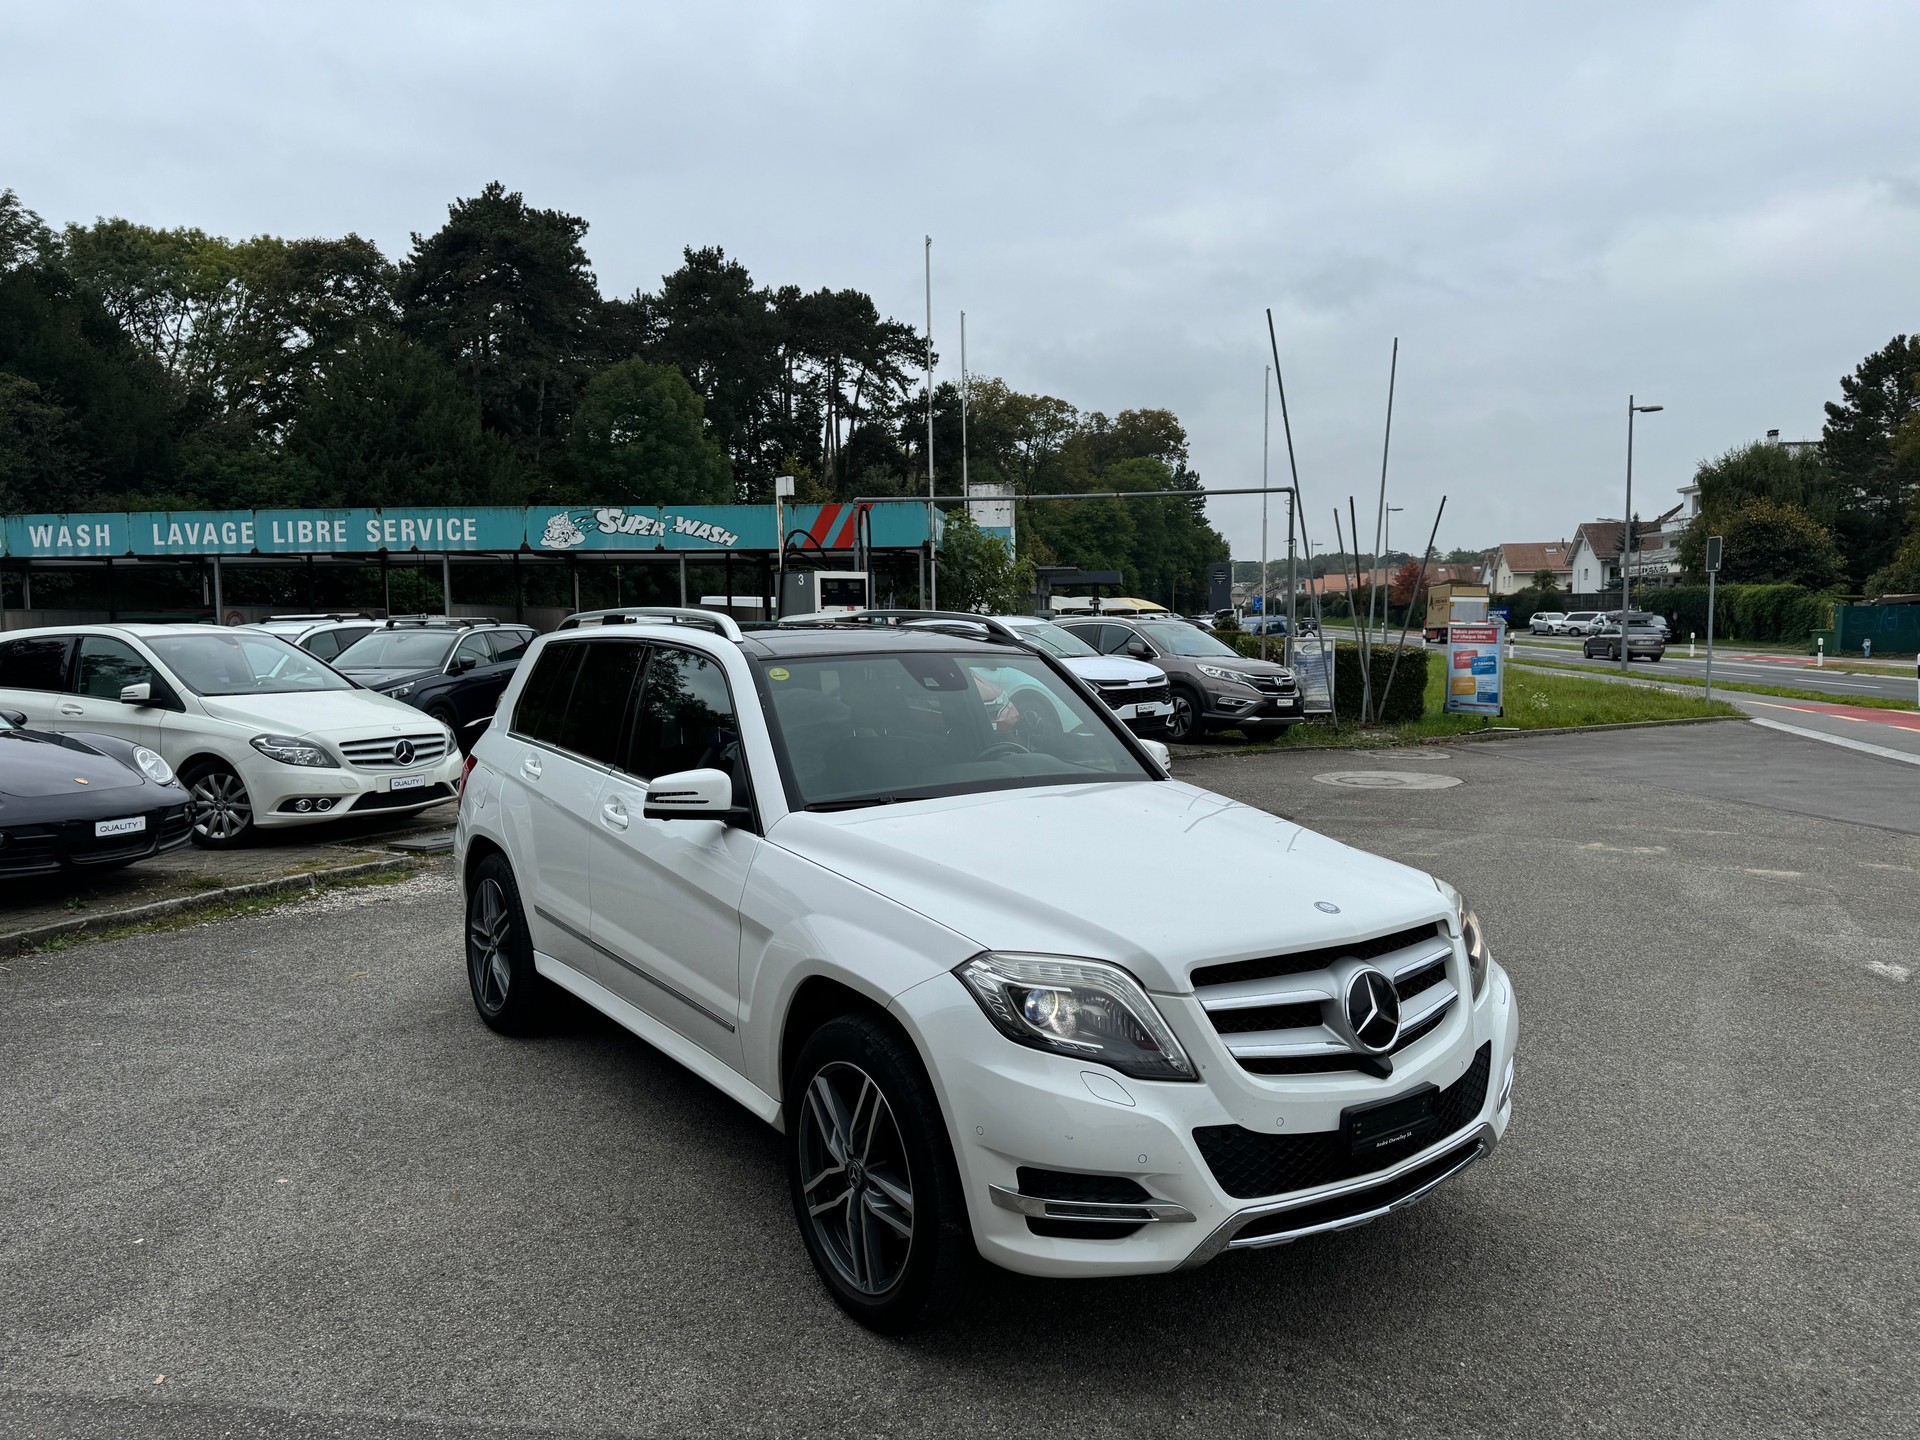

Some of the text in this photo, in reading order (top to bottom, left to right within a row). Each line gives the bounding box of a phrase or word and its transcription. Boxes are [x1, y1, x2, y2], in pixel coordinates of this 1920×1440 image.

[29, 524, 111, 548] WASH
[152, 518, 477, 546] LAVAGE LIBRE SERVICE
[595, 508, 739, 547] SUPER WASH
[798, 574, 805, 586] 3
[394, 779, 420, 787] QUALITY
[100, 822, 138, 833] QUALITY
